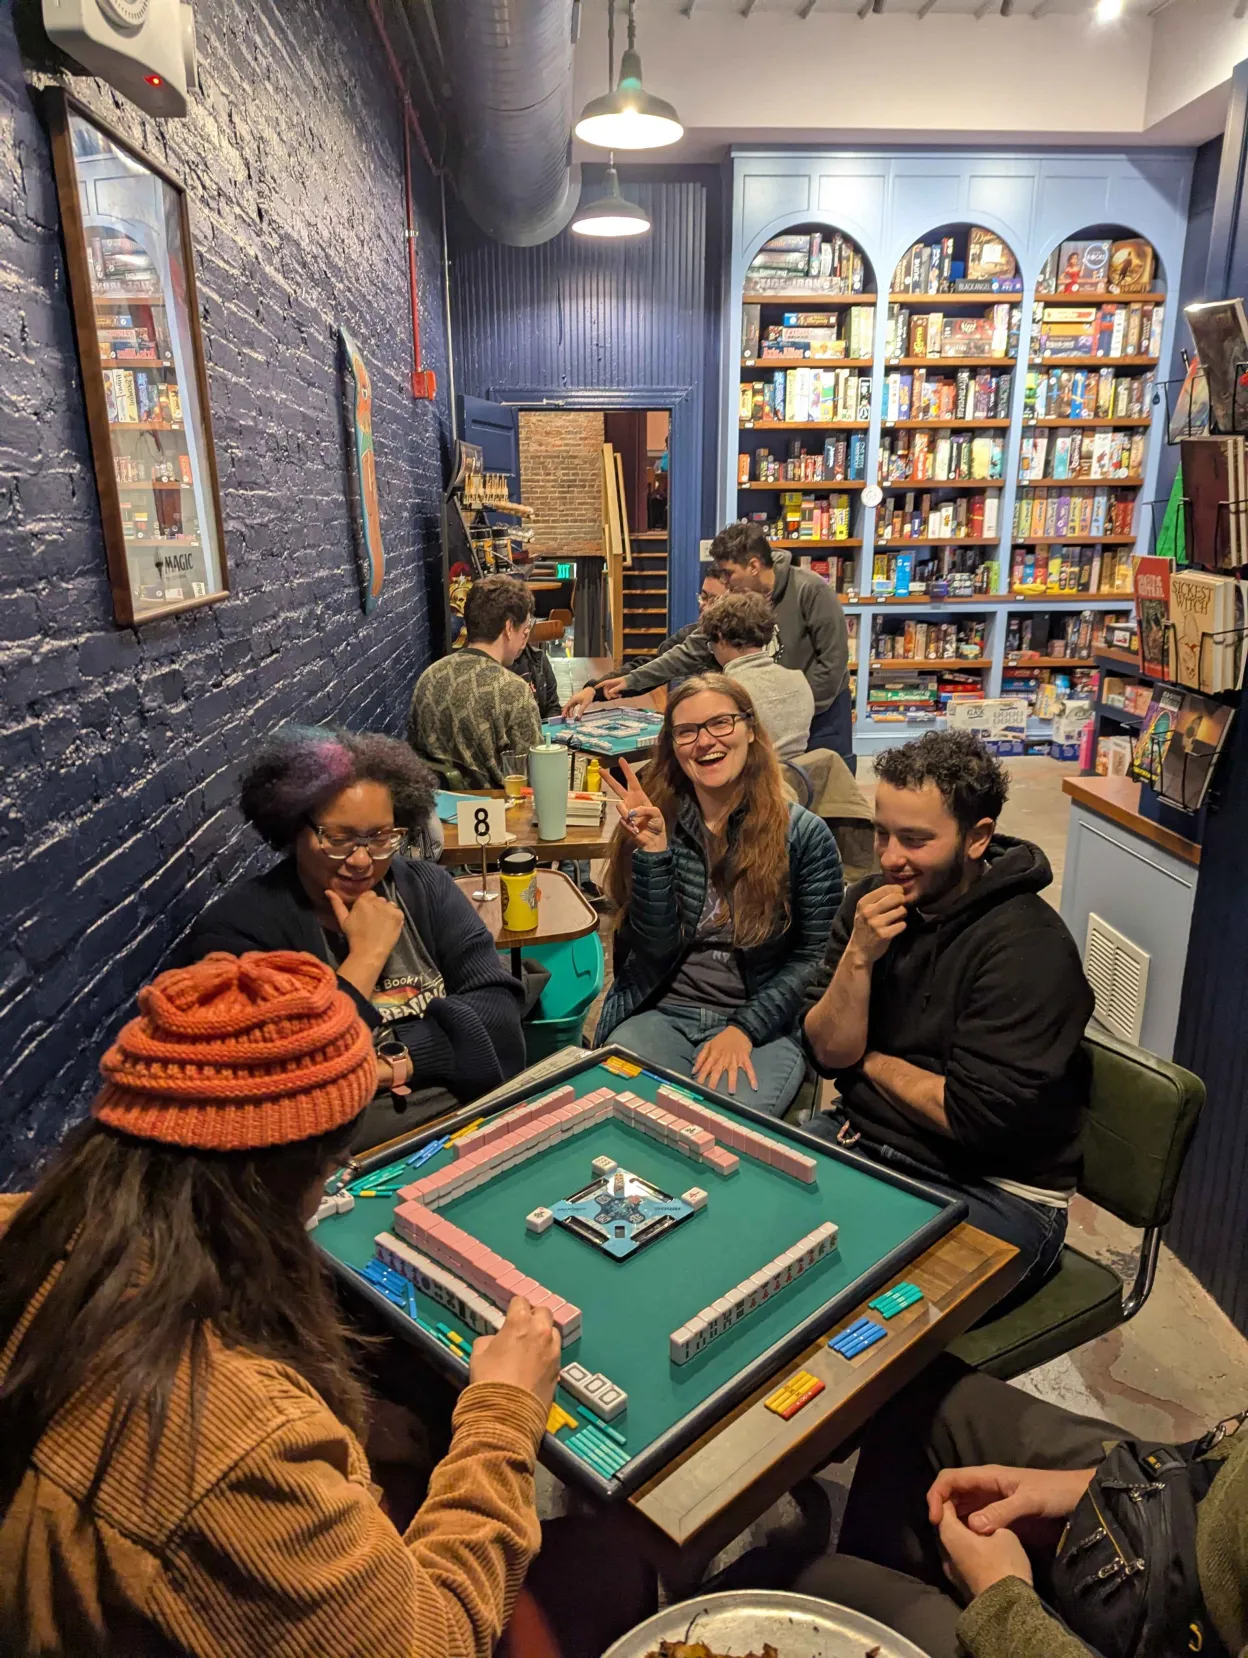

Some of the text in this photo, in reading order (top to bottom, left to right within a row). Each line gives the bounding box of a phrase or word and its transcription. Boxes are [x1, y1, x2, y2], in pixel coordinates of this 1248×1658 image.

[164, 553, 193, 573] MAGIC
[557, 564, 570, 578] XIT
[1172, 581, 1214, 602] SICKEST
[1175, 594, 1209, 615] WITCH
[474, 807, 490, 837] 8
[383, 975, 418, 990] Book!
